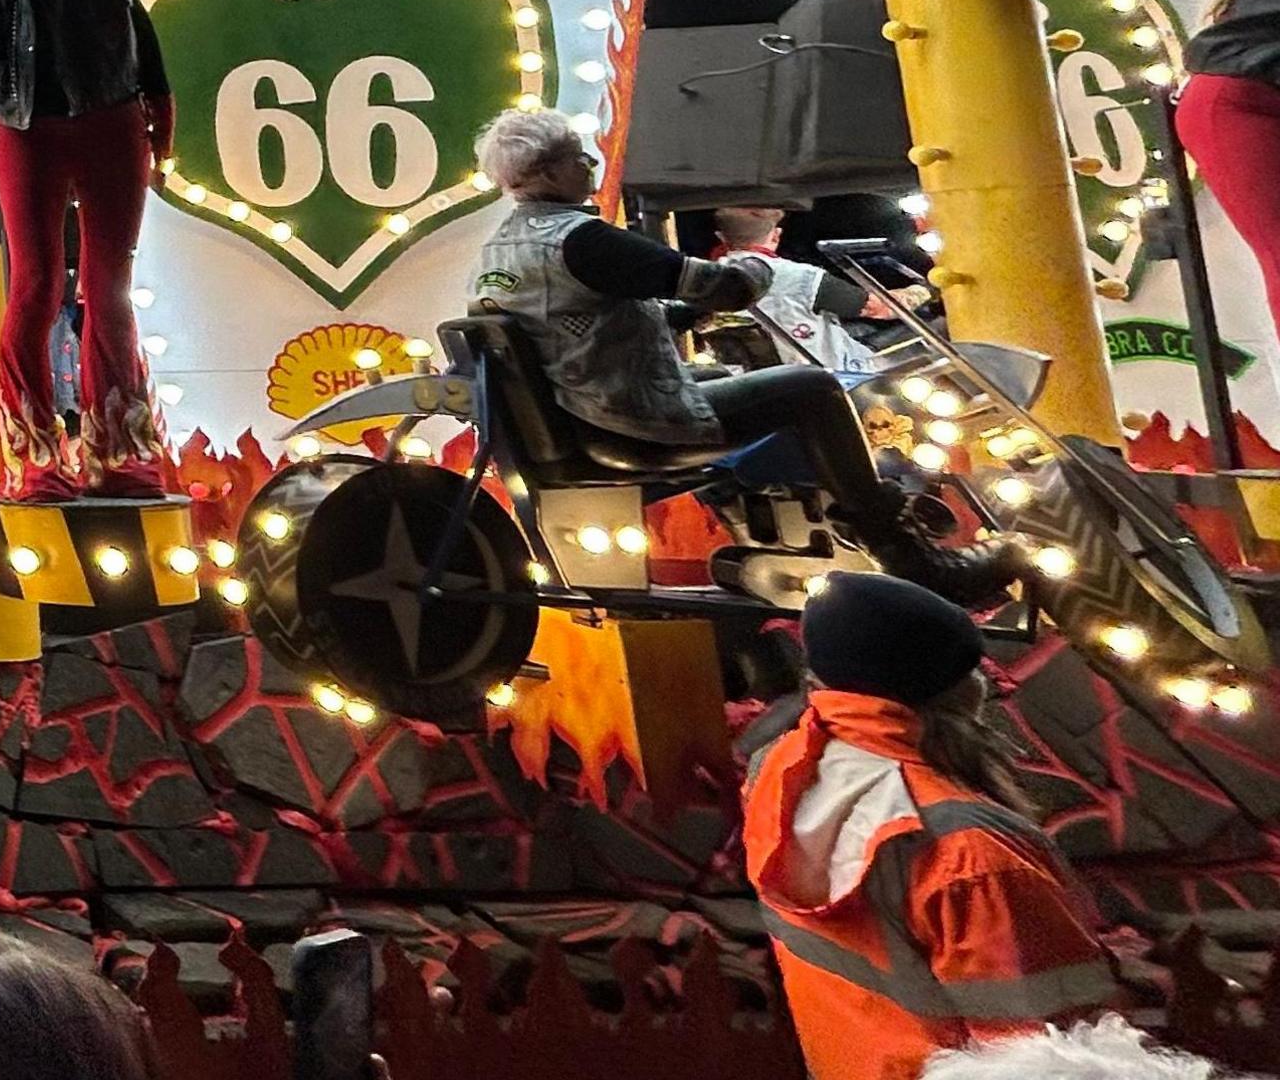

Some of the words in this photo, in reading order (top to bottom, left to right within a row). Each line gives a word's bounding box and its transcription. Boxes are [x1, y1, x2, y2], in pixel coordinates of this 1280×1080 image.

[215, 55, 439, 208] 66
[1057, 50, 1147, 188] 6
[313, 369, 384, 396] SHE
[1105, 329, 1153, 355] BRA
